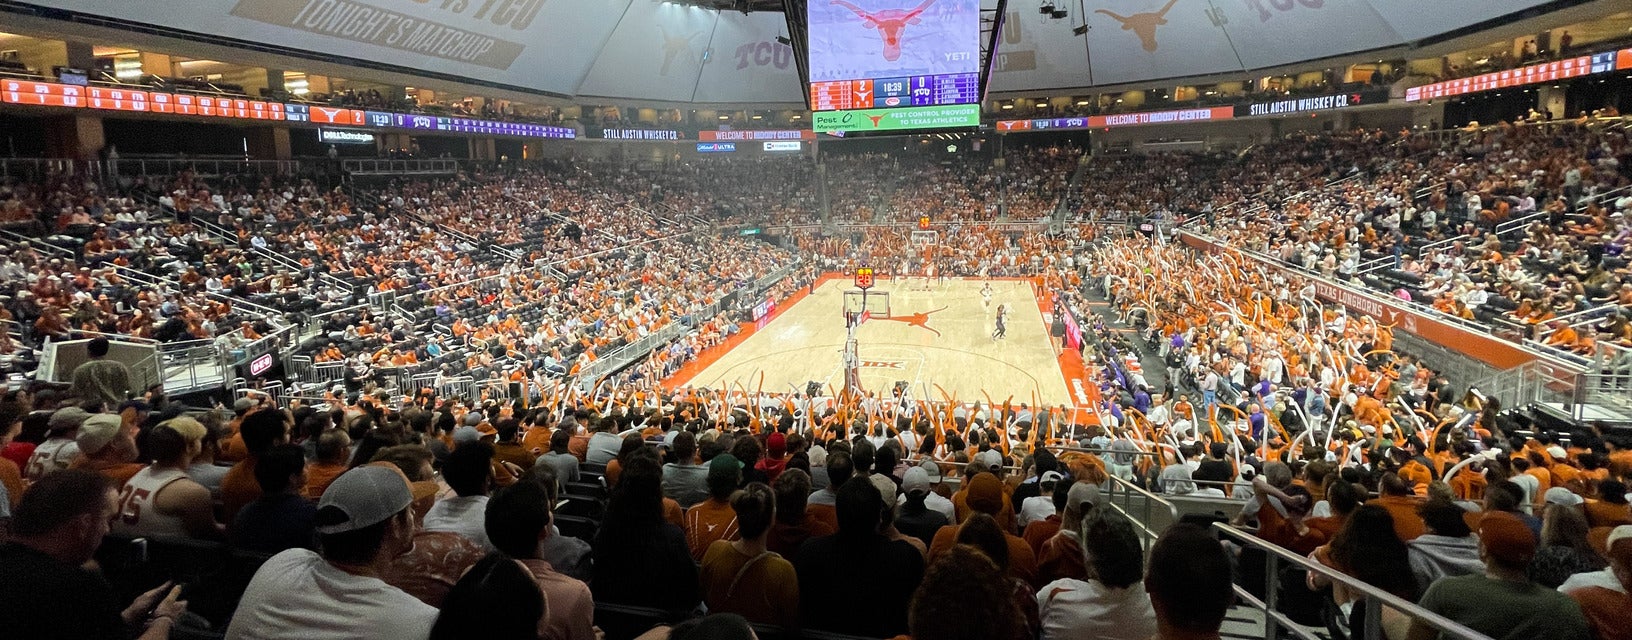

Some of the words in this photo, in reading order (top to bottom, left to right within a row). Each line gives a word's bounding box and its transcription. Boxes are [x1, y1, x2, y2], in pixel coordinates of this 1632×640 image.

[293, 0, 410, 44] TONIGHT'S
[400, 20, 494, 61] MATCHUP
[734, 41, 792, 70] TCU
[945, 52, 970, 61] YETI
[860, 80, 865, 91] 2
[919, 76, 925, 88] 0
[914, 88, 930, 97] TCU
[1250, 103, 1269, 115] STILL
[1270, 100, 1296, 114] AUSTIN
[1298, 96, 1334, 111] WHISKEY
[1335, 95, 1349, 107] CO.
[355, 112, 361, 122] 2
[908, 110, 940, 118] CONTROL
[941, 108, 975, 117] PROVIDER
[1106, 114, 1138, 125] WELCOME
[1139, 113, 1149, 123] TO
[1150, 111, 1178, 122] MOODY
[1179, 109, 1211, 120] CENTER
[398, 115, 403, 125] 0
[413, 116, 430, 128] TCU
[932, 116, 968, 125] ATHLETICS
[1066, 118, 1082, 127] TCU
[603, 129, 620, 139] STILL
[622, 129, 643, 140] AUSTIN
[644, 130, 669, 140] WHISKEY
[669, 130, 678, 140] CO.
[715, 131, 744, 140] WELCOME
[746, 131, 753, 139] TO
[1316, 282, 1337, 300] TEXAS
[1338, 288, 1383, 317] LONGHORNS
